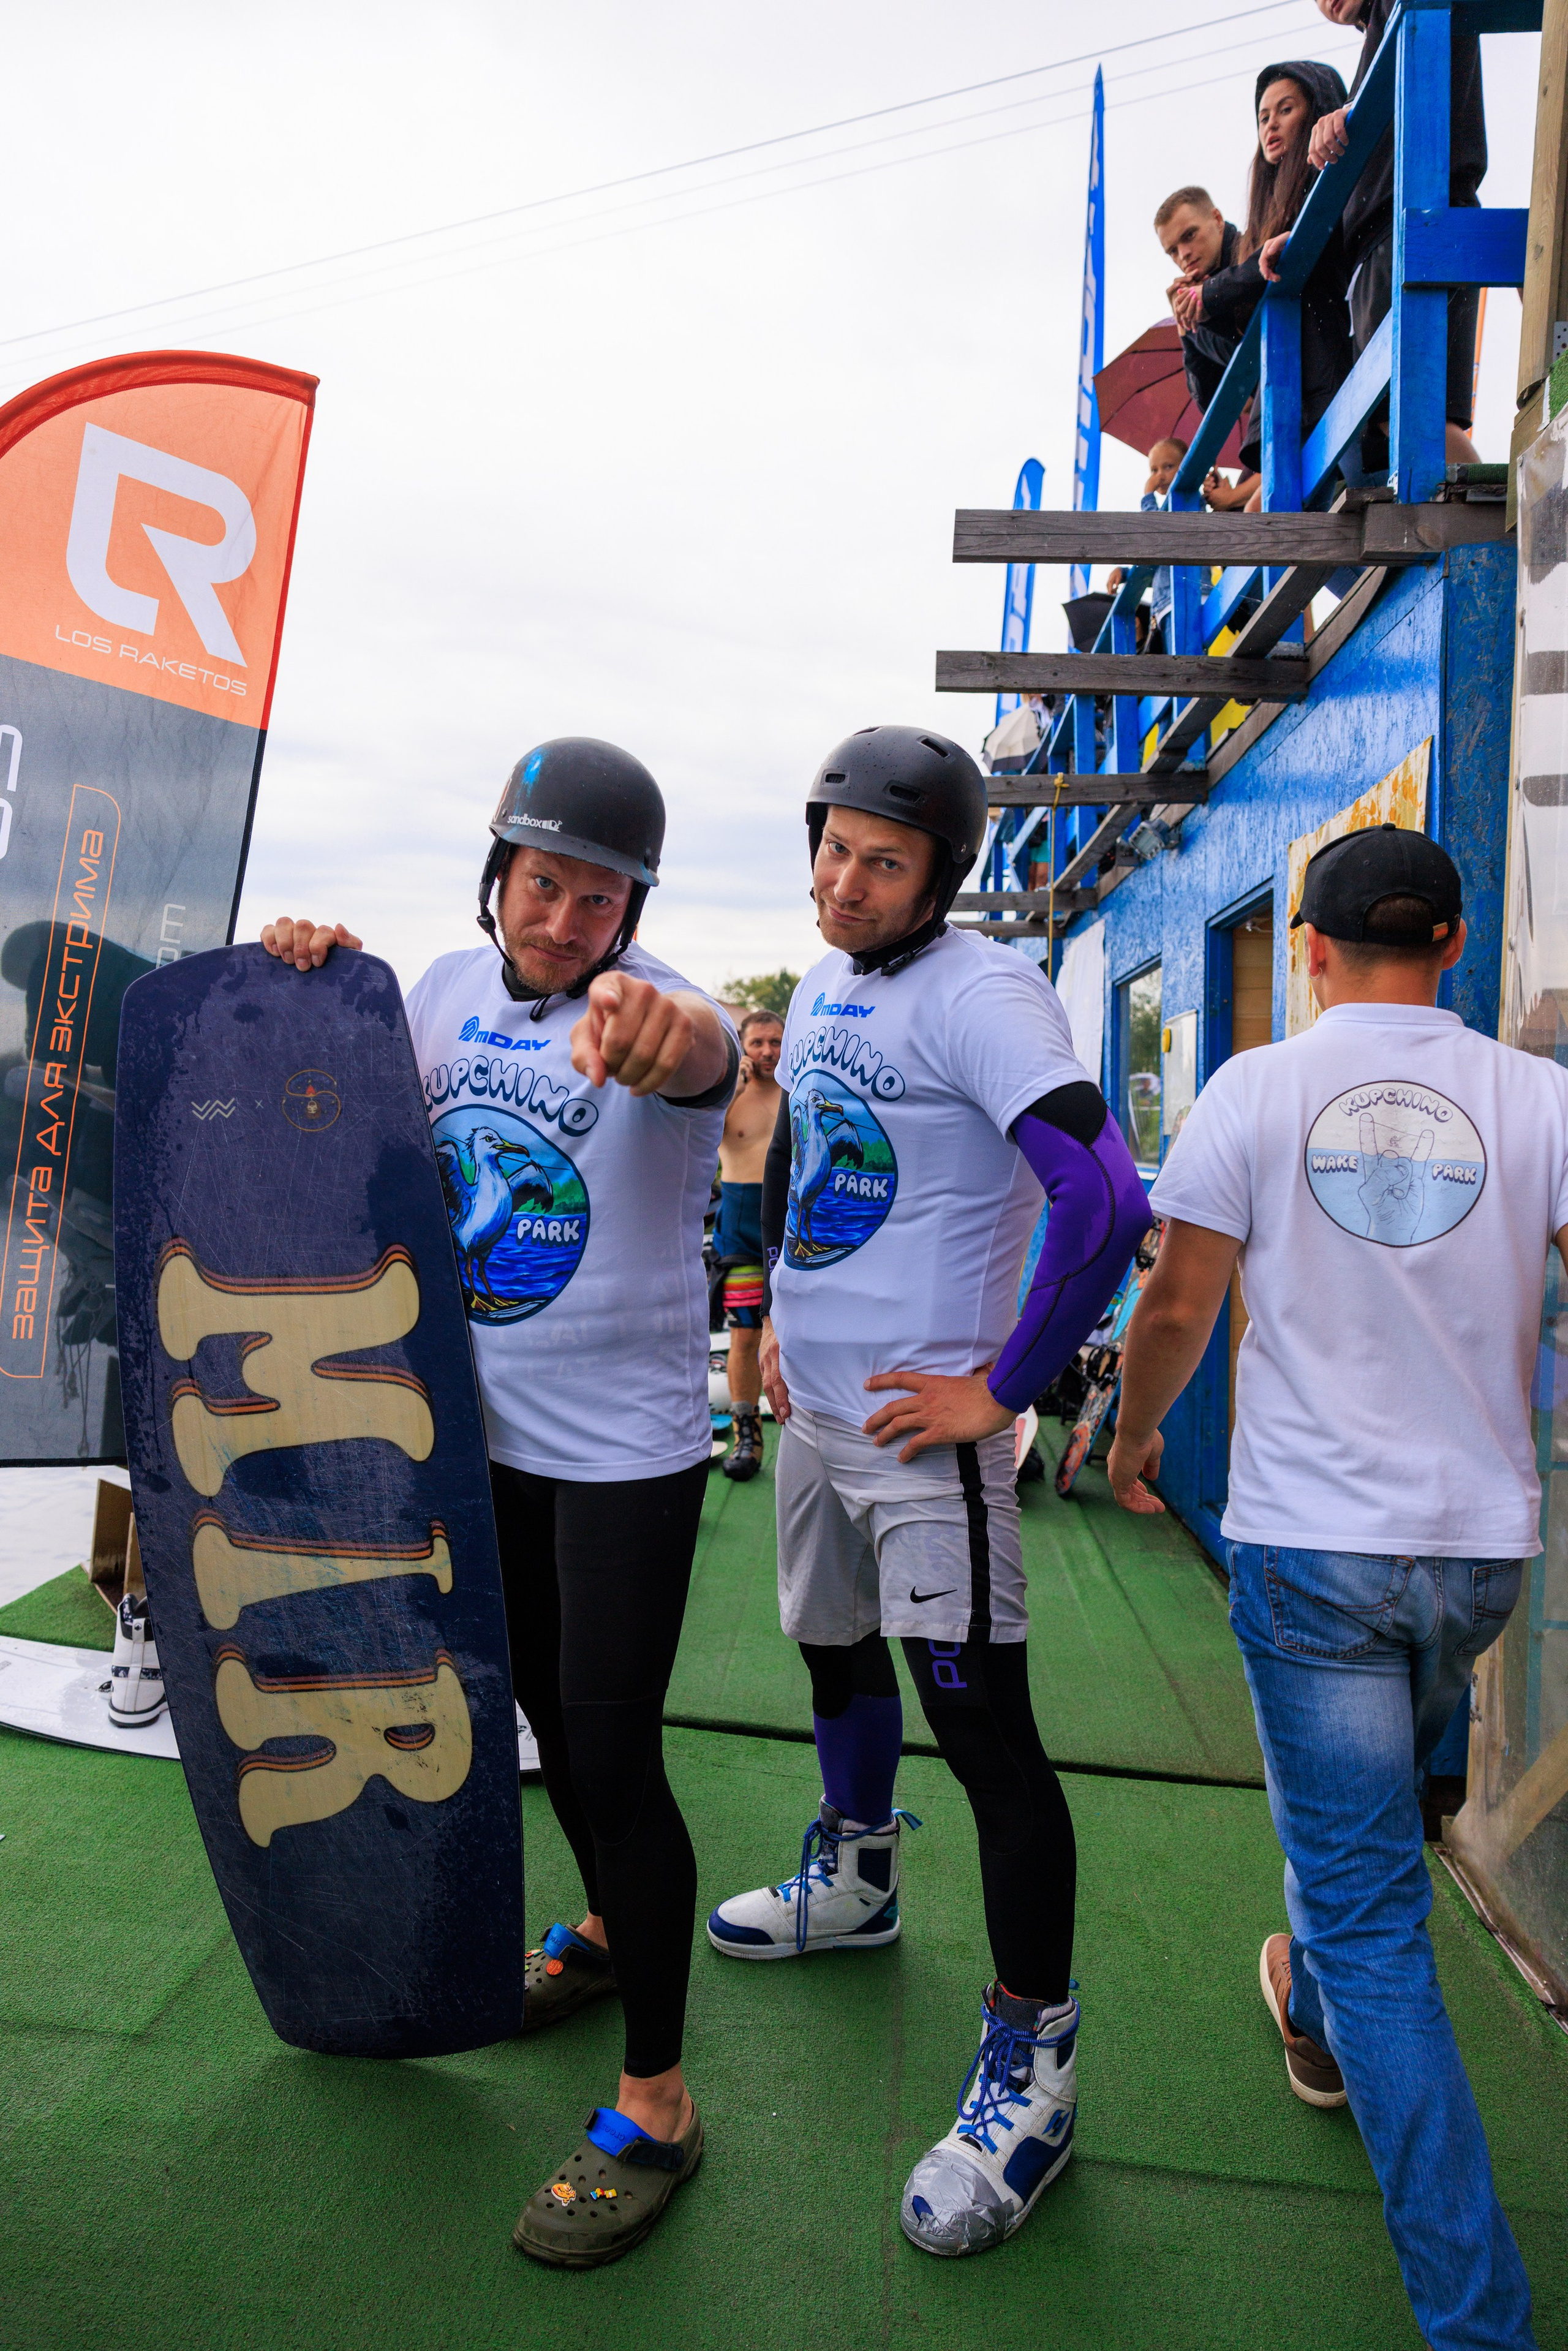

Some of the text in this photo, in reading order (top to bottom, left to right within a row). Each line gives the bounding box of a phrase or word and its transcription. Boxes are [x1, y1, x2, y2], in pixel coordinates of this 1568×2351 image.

[55, 624, 247, 696] LOS RAKETOS
[507, 813, 543, 829] sandbox
[1339, 1087, 1453, 1123] KUPCHINO
[1311, 1154, 1359, 1173] WAKE
[1432, 1163, 1477, 1185] PARK
[834, 1172, 889, 1203] PARK
[516, 1218, 580, 1248] PARK
[155, 1237, 473, 1848] MIR
